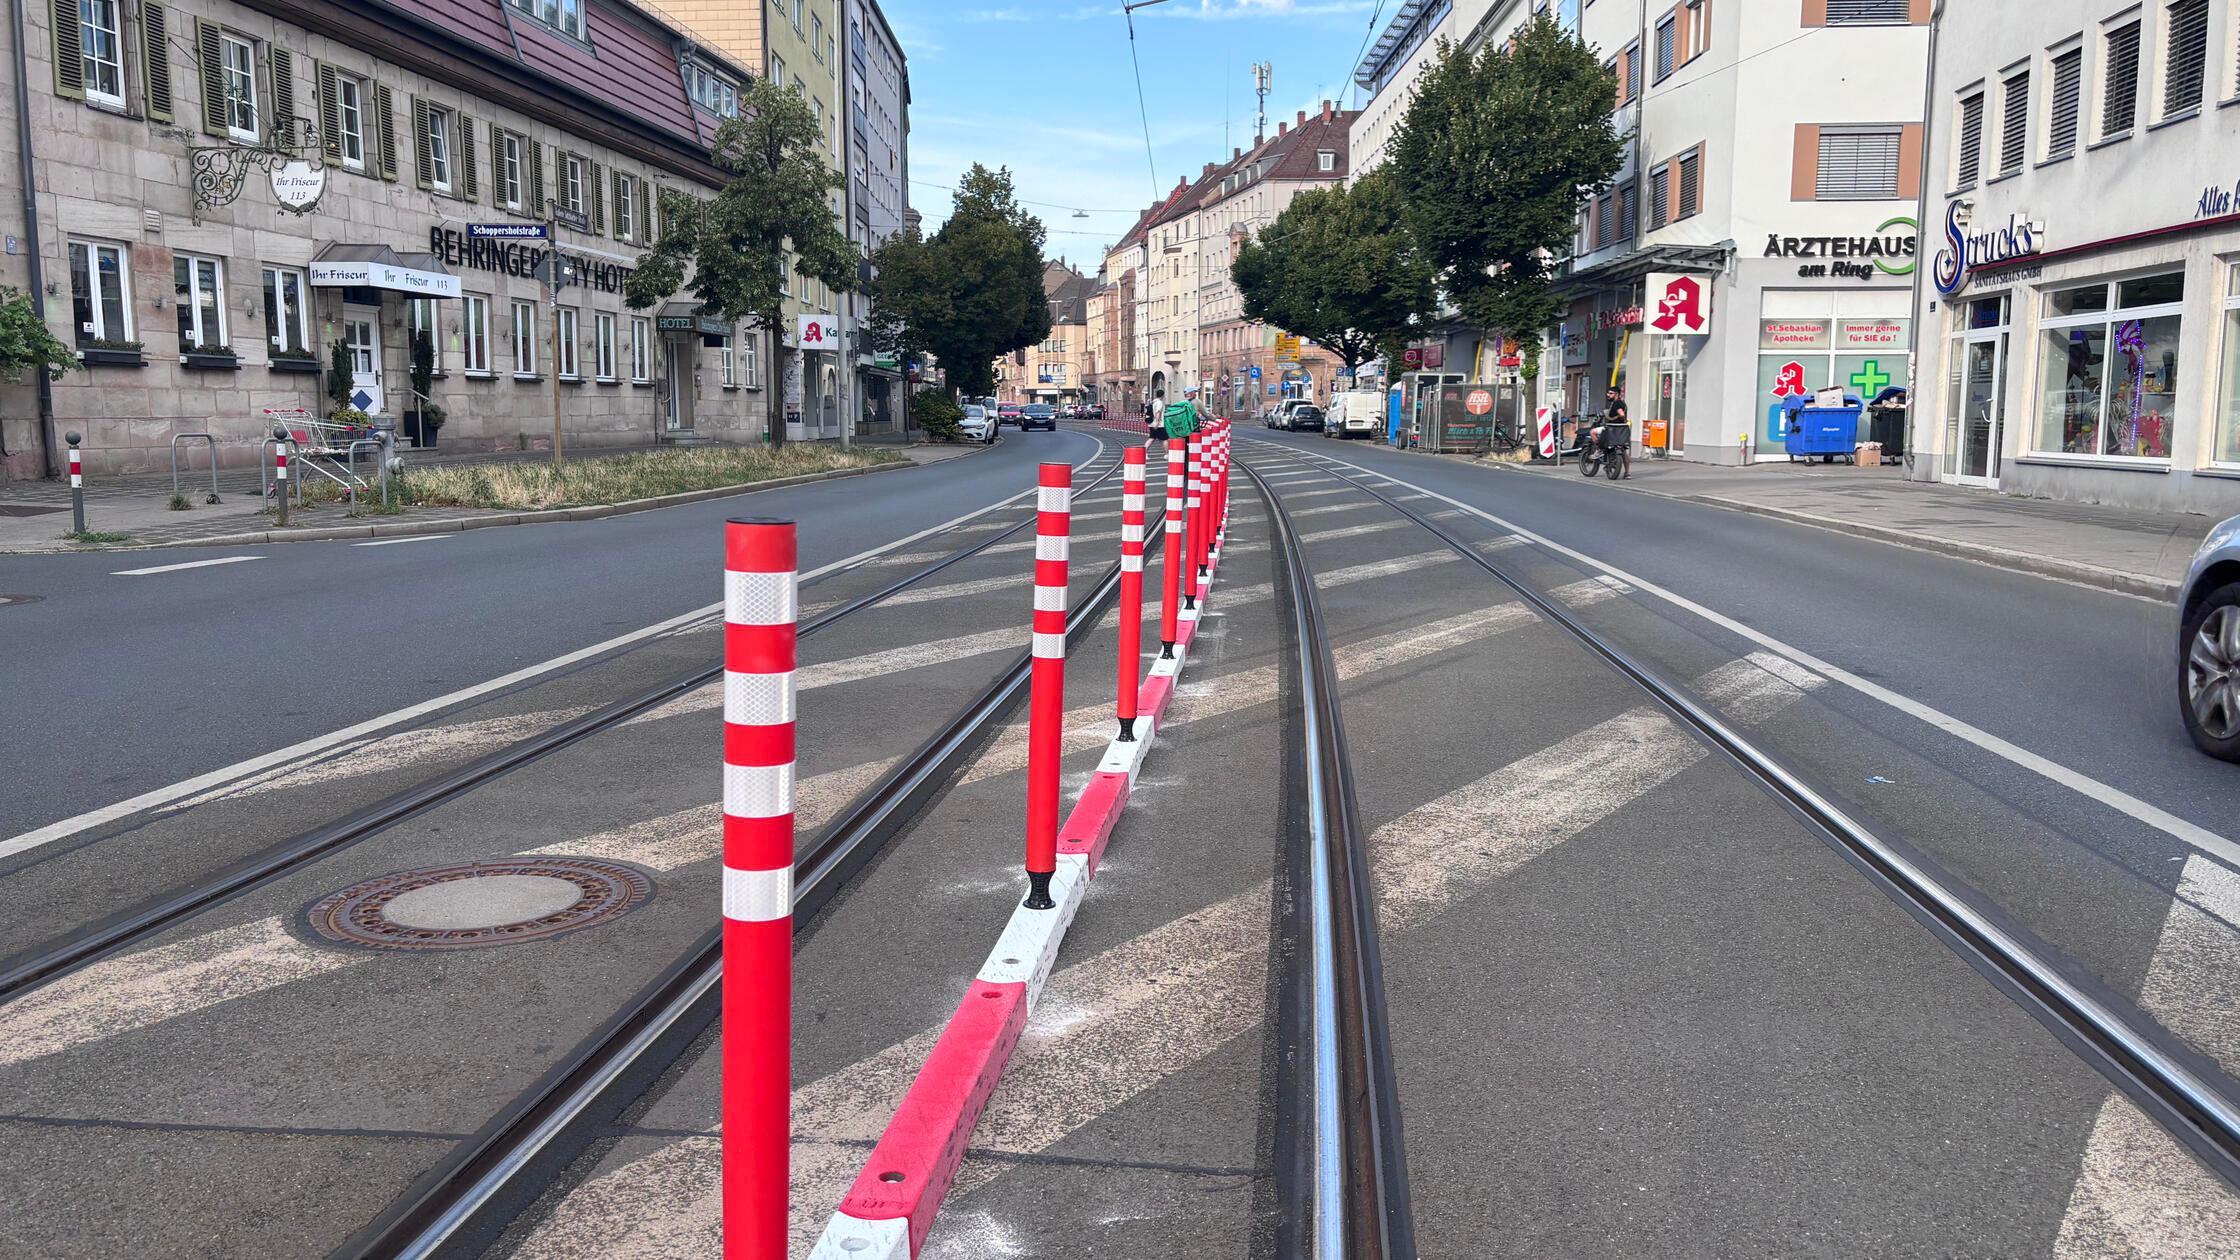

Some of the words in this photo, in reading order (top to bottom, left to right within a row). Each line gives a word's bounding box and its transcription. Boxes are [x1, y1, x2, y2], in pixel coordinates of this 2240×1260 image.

[276, 176, 289, 186] Ihr
[290, 177, 320, 186] Friseur
[290, 191, 306, 200] 113
[2194, 185, 2230, 218] Alles
[472, 225, 541, 237] Schoppershofstraße
[1763, 233, 1916, 257] ÄRZTEHAUS
[1933, 199, 2032, 294] Strucks
[430, 226, 553, 279] BEHRINGER
[312, 269, 328, 280] Ihr
[329, 269, 368, 280] Friseur
[1798, 264, 1826, 277] am
[1830, 261, 1874, 281] Ring
[384, 269, 396, 283] Ihr
[405, 273, 429, 287] Friseur
[437, 279, 448, 290] 113
[659, 318, 693, 329] HOTEL
[1845, 324, 1873, 332] Immer
[1875, 324, 1902, 334] gerne
[1773, 334, 1815, 343] Apotheke
[1849, 334, 1862, 342] für
[1864, 334, 1878, 342] SIE
[1880, 334, 1891, 342] da
